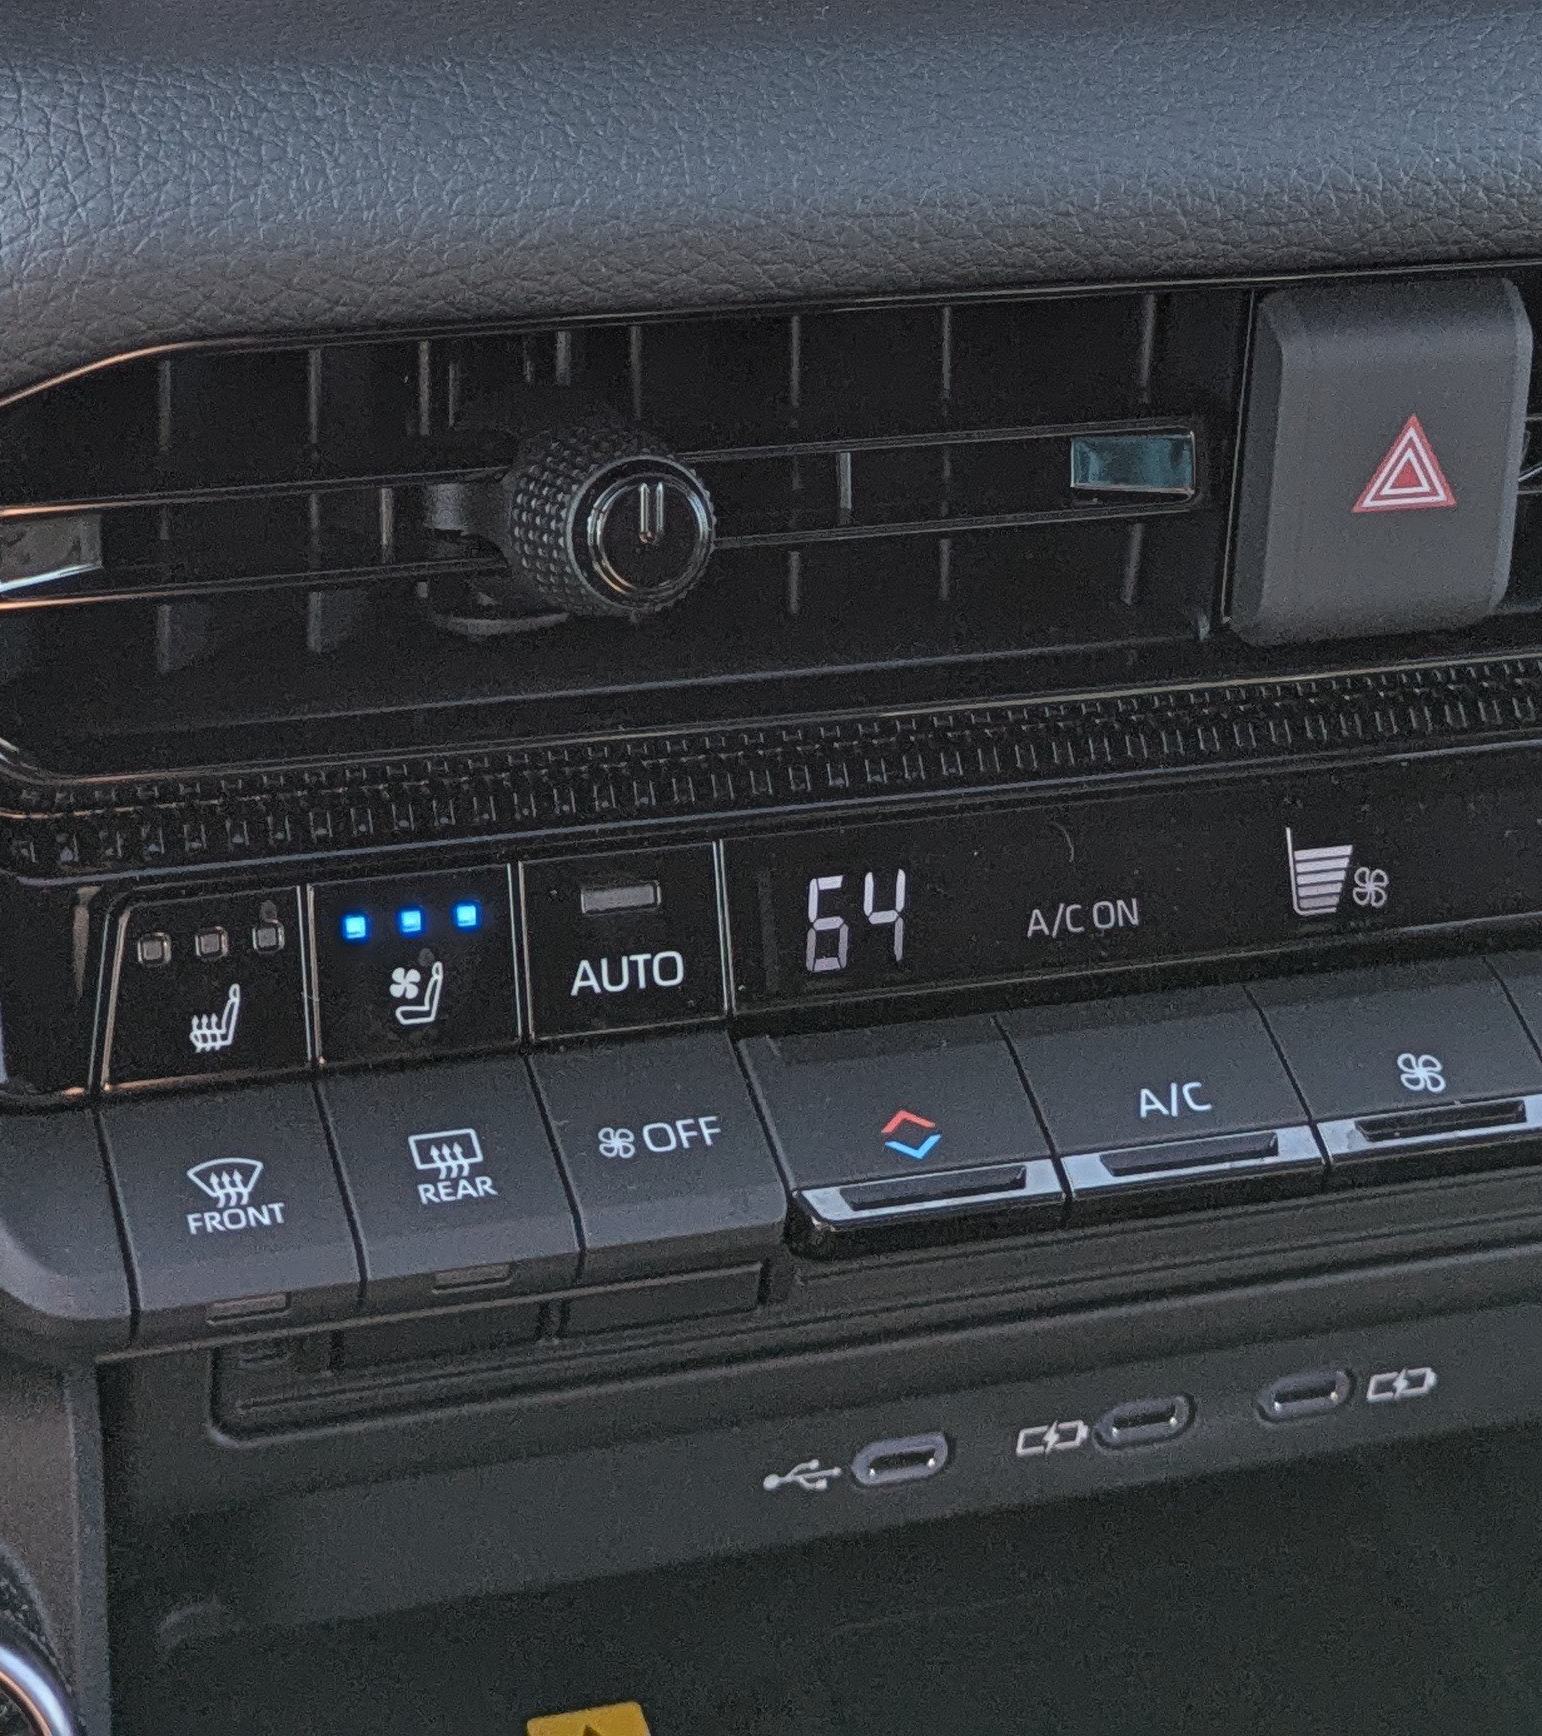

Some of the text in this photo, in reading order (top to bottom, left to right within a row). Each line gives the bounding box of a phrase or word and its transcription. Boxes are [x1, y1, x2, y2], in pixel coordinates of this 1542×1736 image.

[805, 868, 906, 974] 64
[1026, 897, 1140, 940] A/C ON
[570, 950, 685, 997] AUTO
[1137, 1081, 1212, 1120] A/C
[643, 1115, 721, 1154] OFF
[417, 1175, 498, 1206] REAR
[185, 1201, 285, 1235] FRONT
